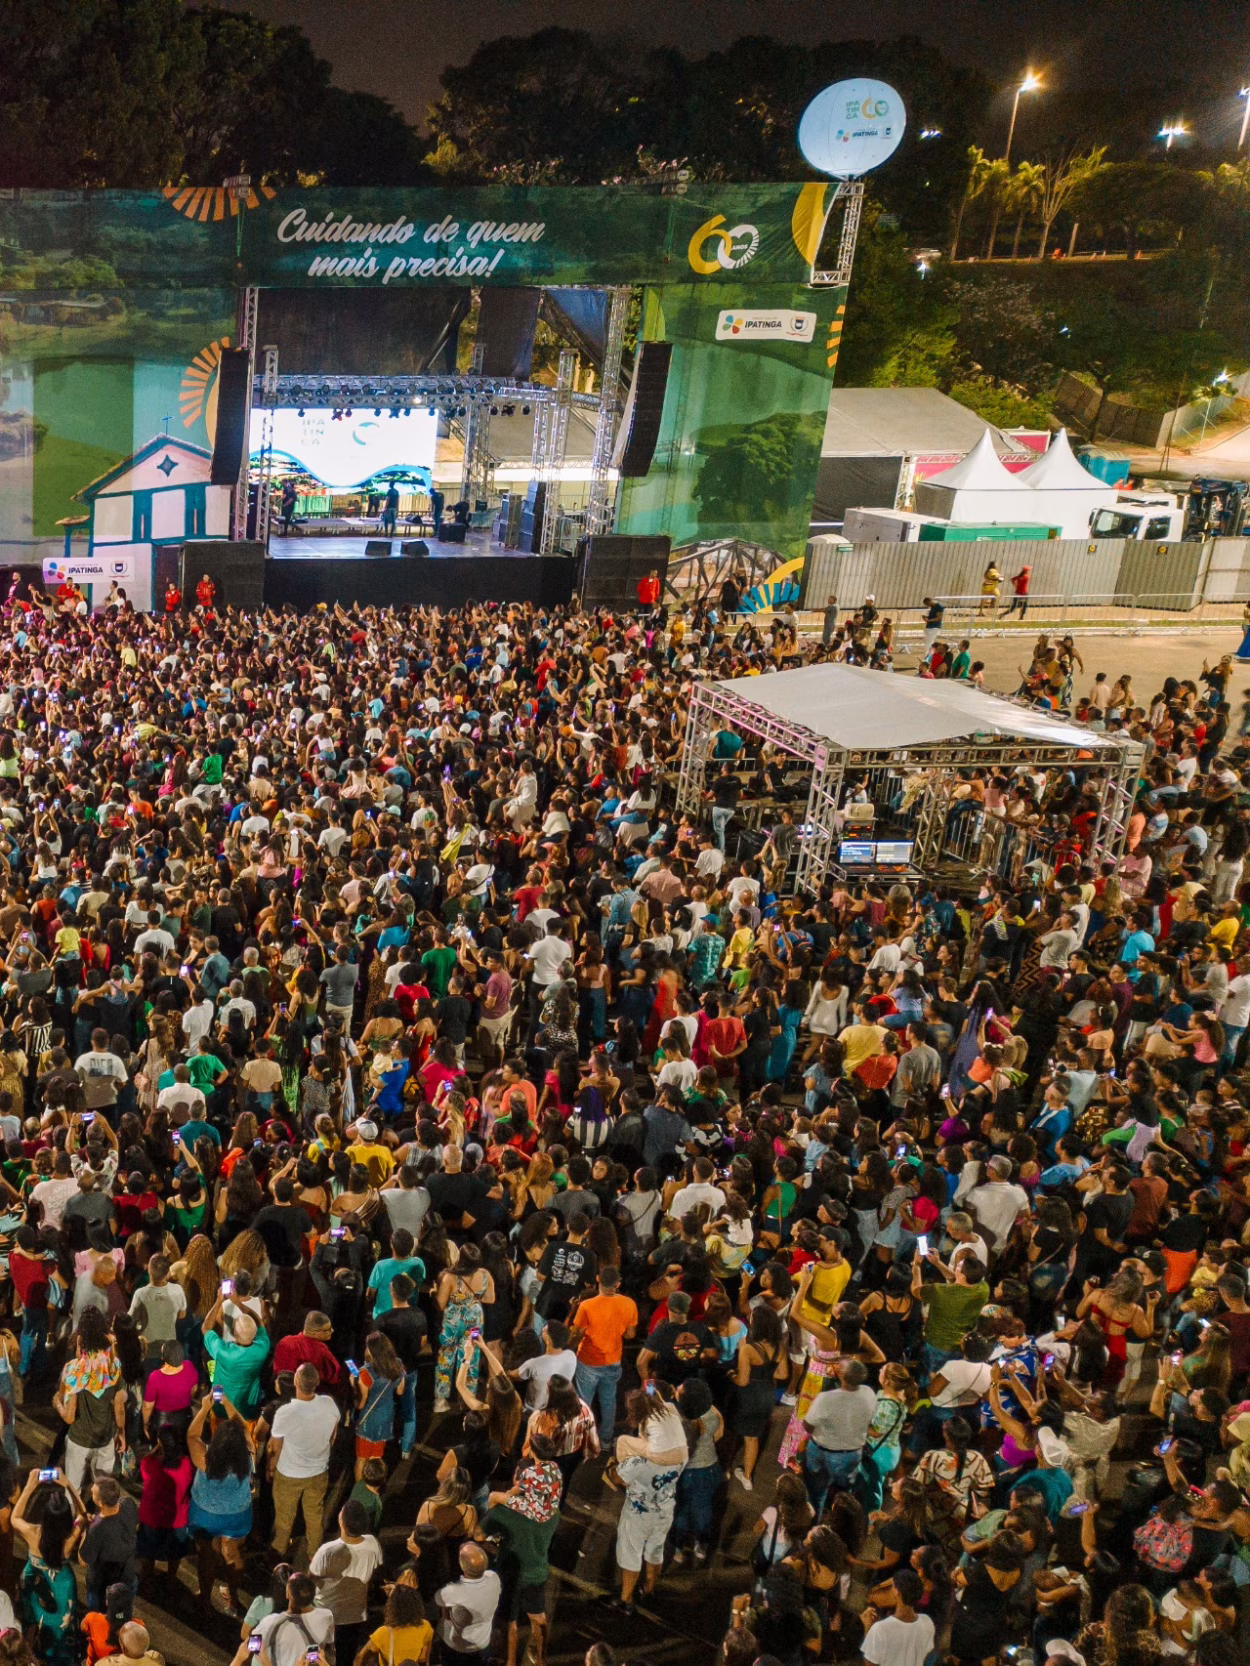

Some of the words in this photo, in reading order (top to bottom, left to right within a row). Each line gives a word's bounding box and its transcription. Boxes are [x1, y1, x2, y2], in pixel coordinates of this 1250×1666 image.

[277, 208, 416, 244] Cuidando
[423, 214, 458, 244] de
[466, 219, 546, 248] quem
[307, 246, 379, 278] mais
[382, 246, 505, 285] precisa!
[745, 320, 782, 329] IPATINGA
[68, 566, 104, 574] IPATINGA
